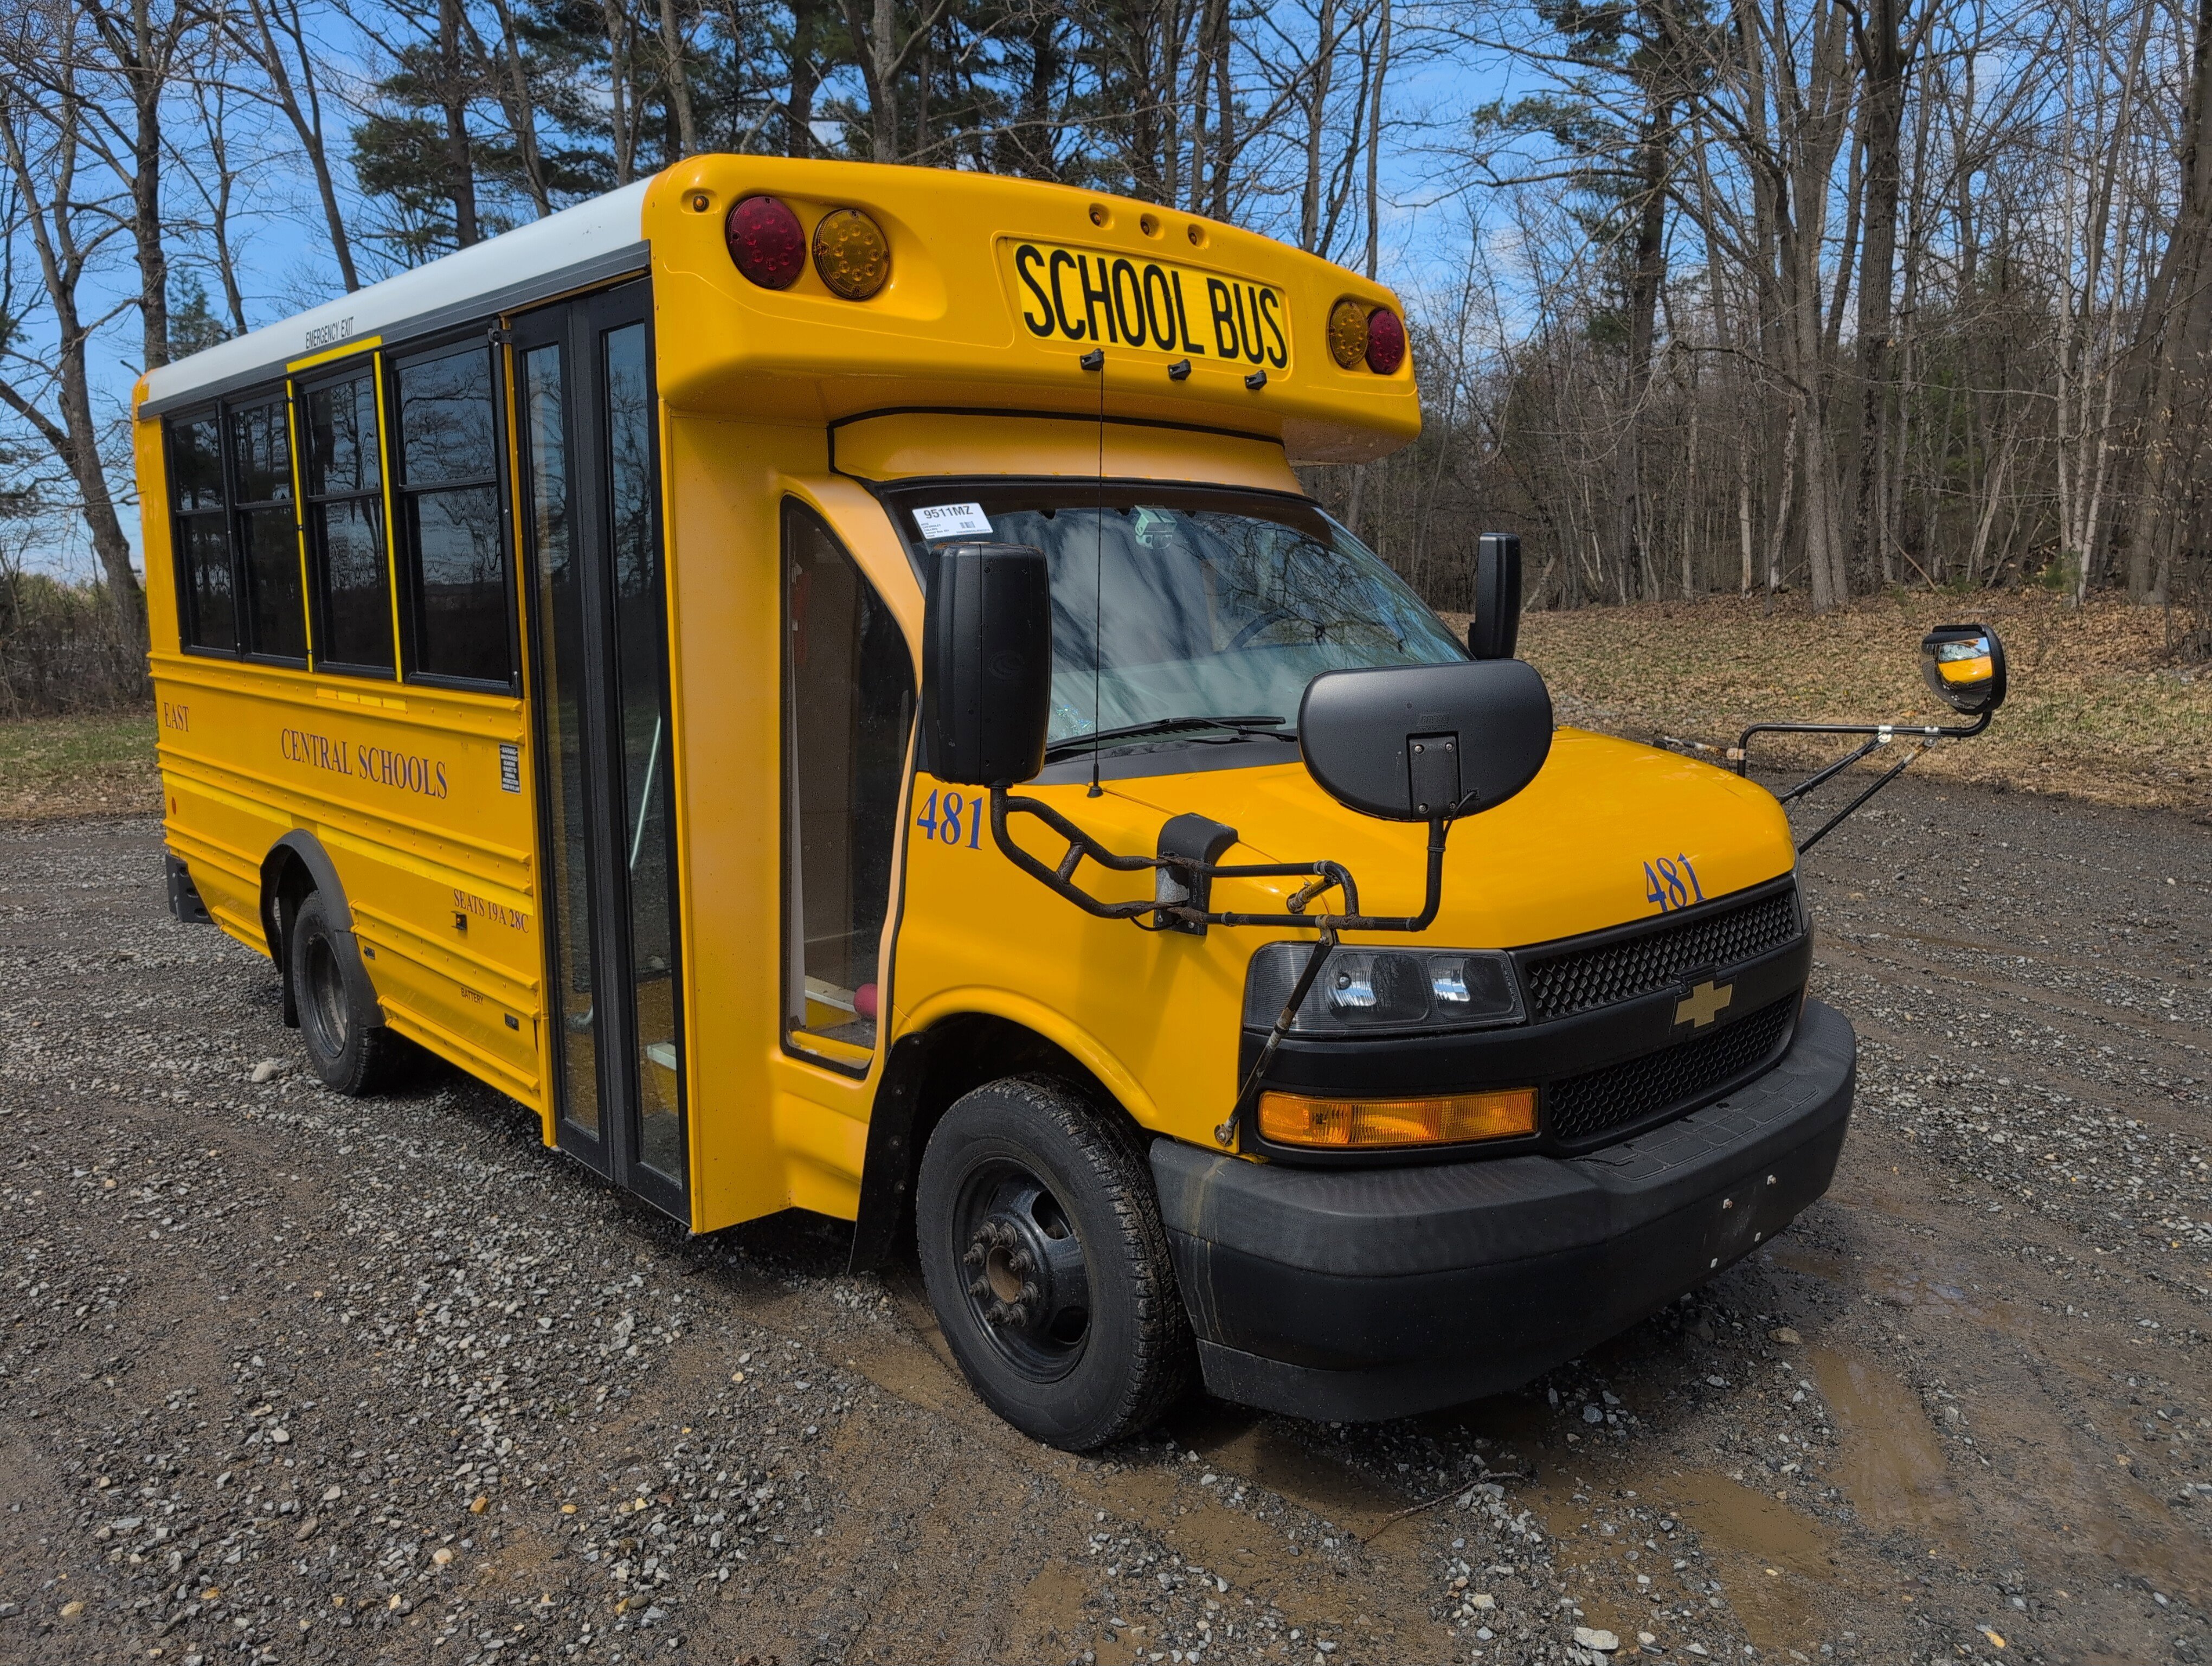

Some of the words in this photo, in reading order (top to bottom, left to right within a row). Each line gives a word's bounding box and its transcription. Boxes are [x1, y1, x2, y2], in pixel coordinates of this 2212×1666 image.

[1015, 244, 1205, 355] SCHOOL
[1206, 277, 1288, 369] BUS
[306, 321, 339, 349] EMERGENCY
[341, 316, 354, 337] EXIT
[924, 505, 974, 519] 9511MZ
[164, 702, 189, 732] EAST
[281, 728, 352, 776] CENTRAL
[358, 745, 448, 799] SCHOOLS
[917, 789, 983, 850] 481
[1643, 853, 1707, 913] 481
[453, 888, 485, 917] SEATS
[488, 901, 507, 925] 19A
[509, 909, 529, 934] 28C
[461, 987, 484, 1006] BATTERY
